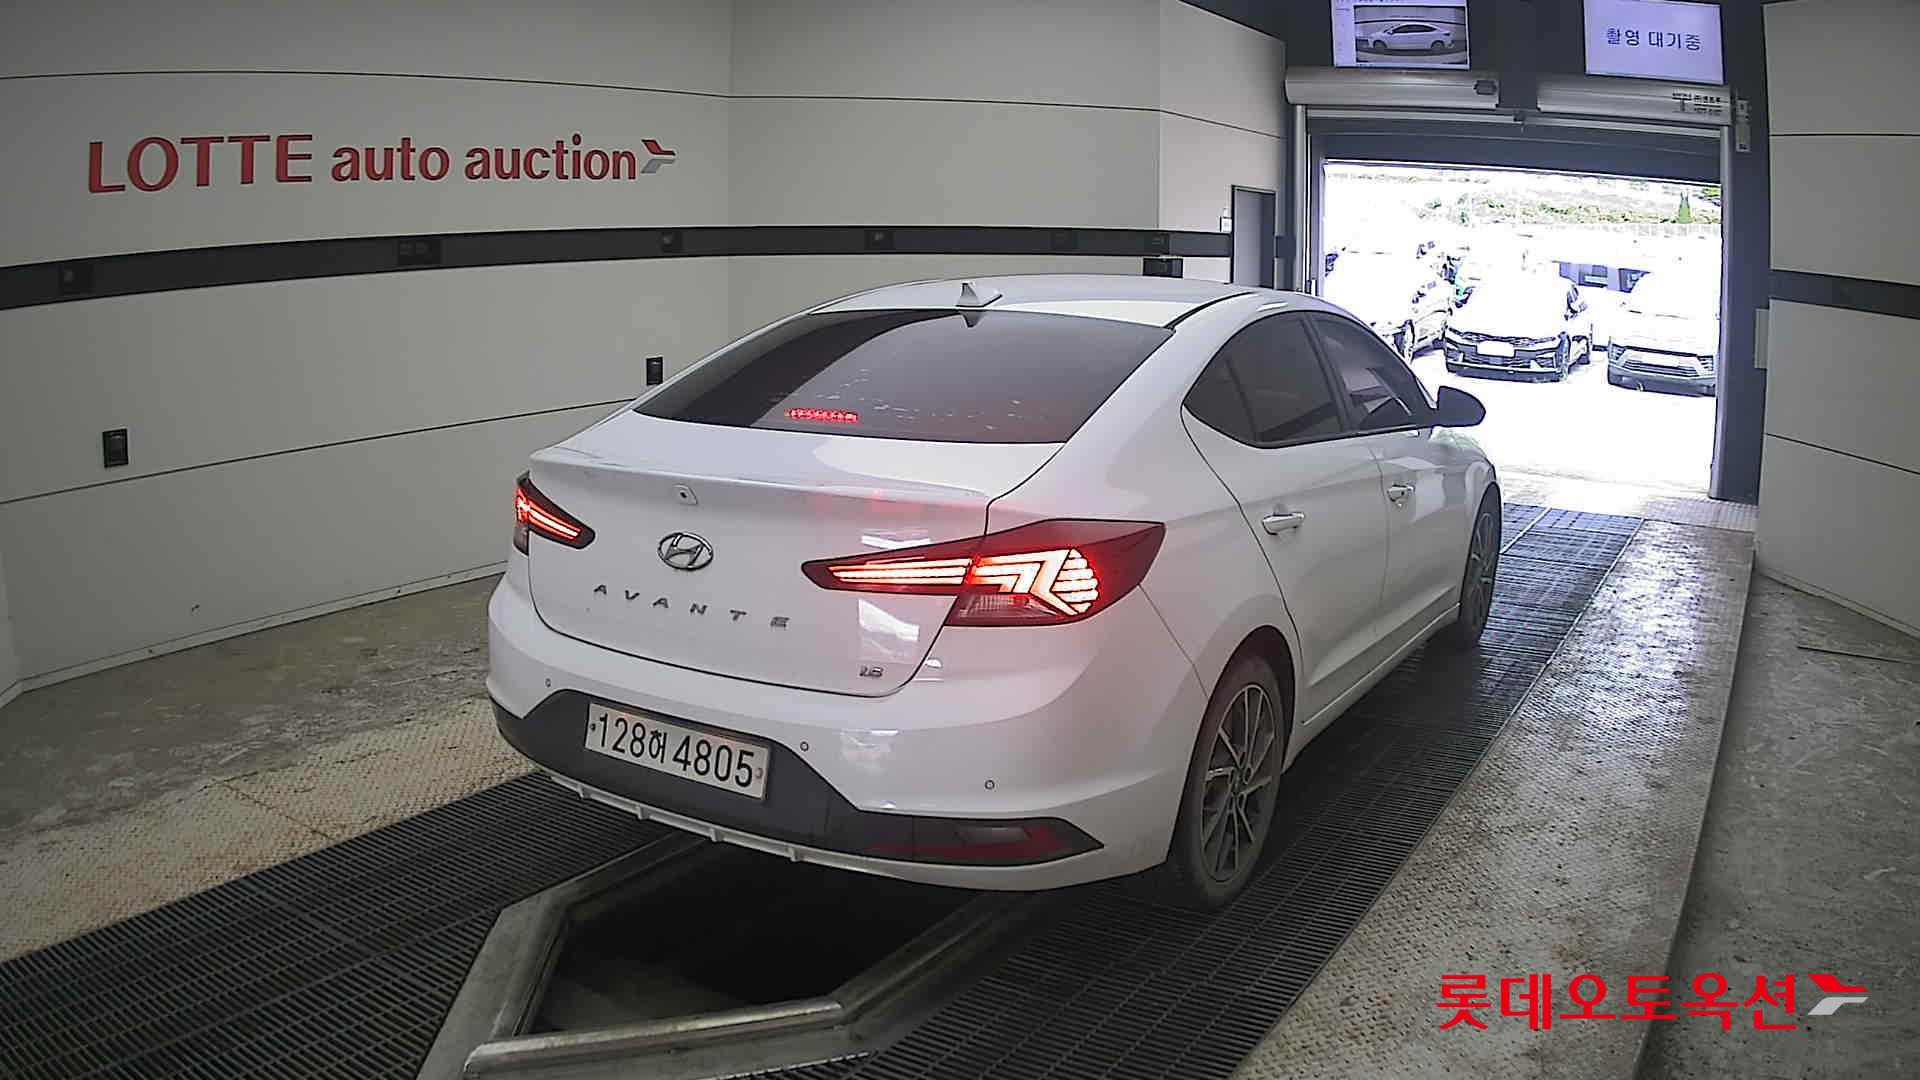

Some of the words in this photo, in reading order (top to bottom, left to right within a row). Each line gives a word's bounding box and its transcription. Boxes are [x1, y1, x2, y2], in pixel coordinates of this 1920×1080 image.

[1647, 31, 1702, 51] 대기중
[89, 134, 313, 193] LOTTE
[331, 137, 450, 182] auto
[465, 133, 636, 181] auction
[594, 584, 790, 628] AVANTE
